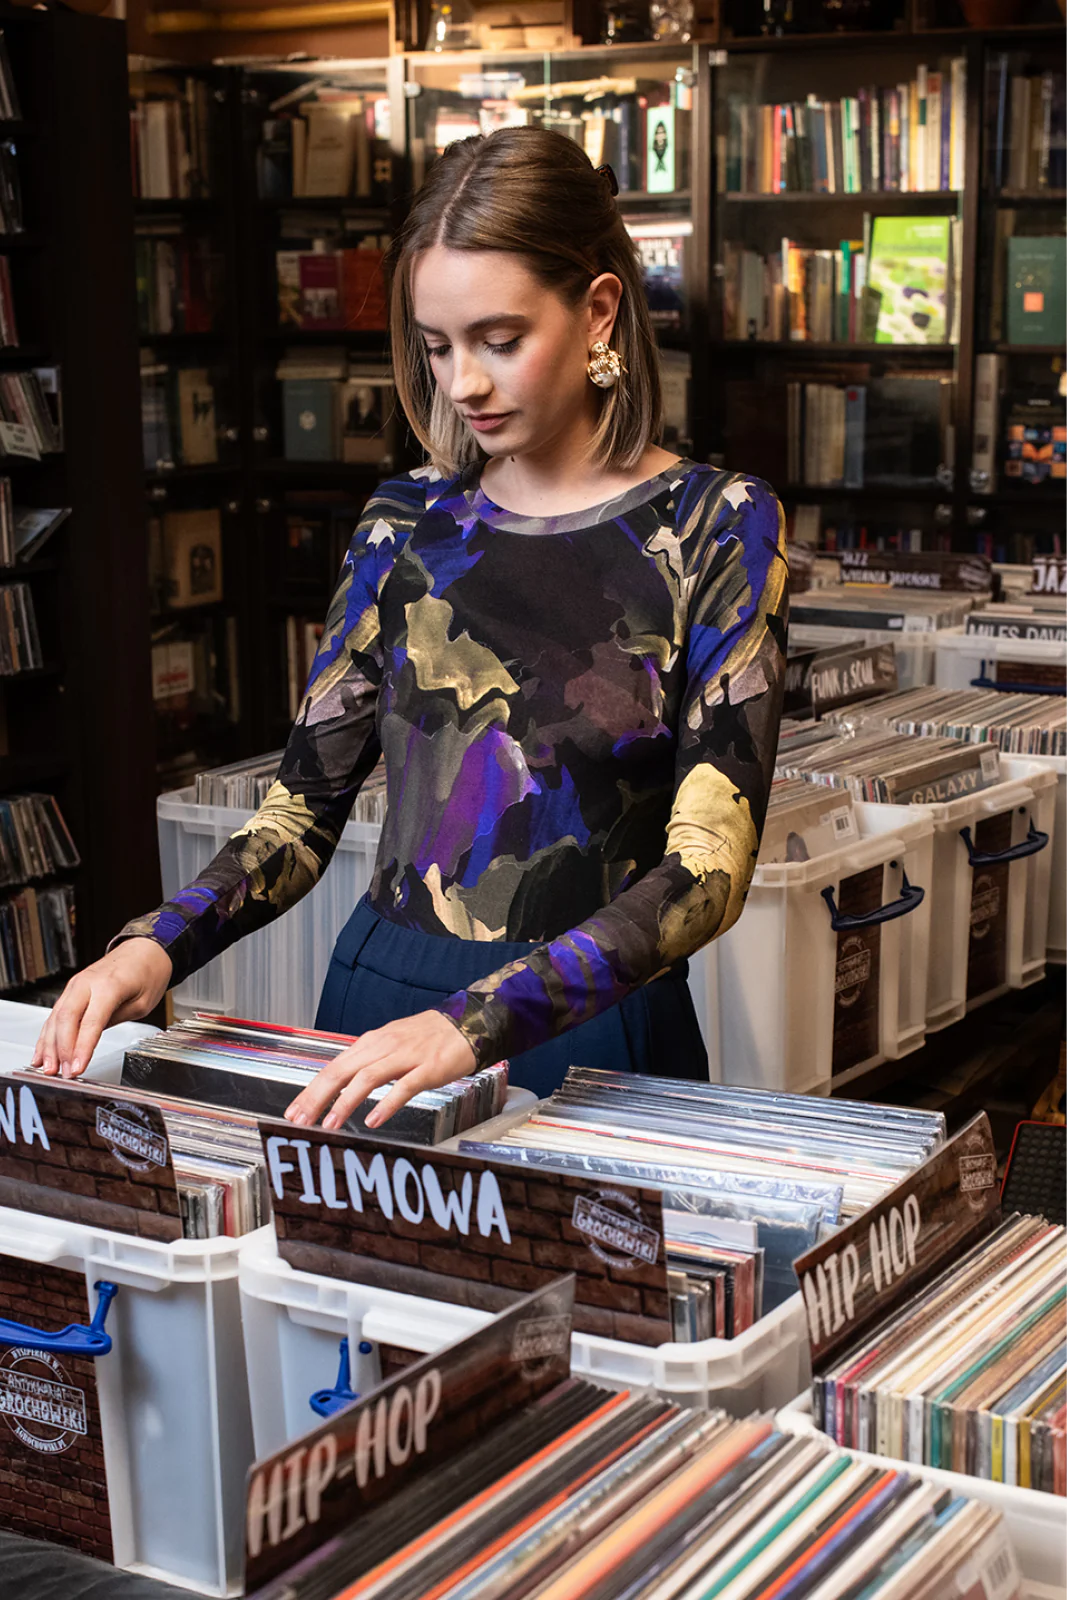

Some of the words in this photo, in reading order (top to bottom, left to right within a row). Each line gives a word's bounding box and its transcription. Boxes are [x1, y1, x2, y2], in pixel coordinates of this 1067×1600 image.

[811, 667, 841, 702] FUNK
[912, 771, 977, 804] GALAXY
[99, 1121, 163, 1163] GROCHOWSKI
[267, 1136, 511, 1244] FILMOWA
[576, 1211, 653, 1260] GROCHOWSKI
[804, 1194, 920, 1345] HIP-HOP
[248, 1368, 441, 1558] HIP-HOP
